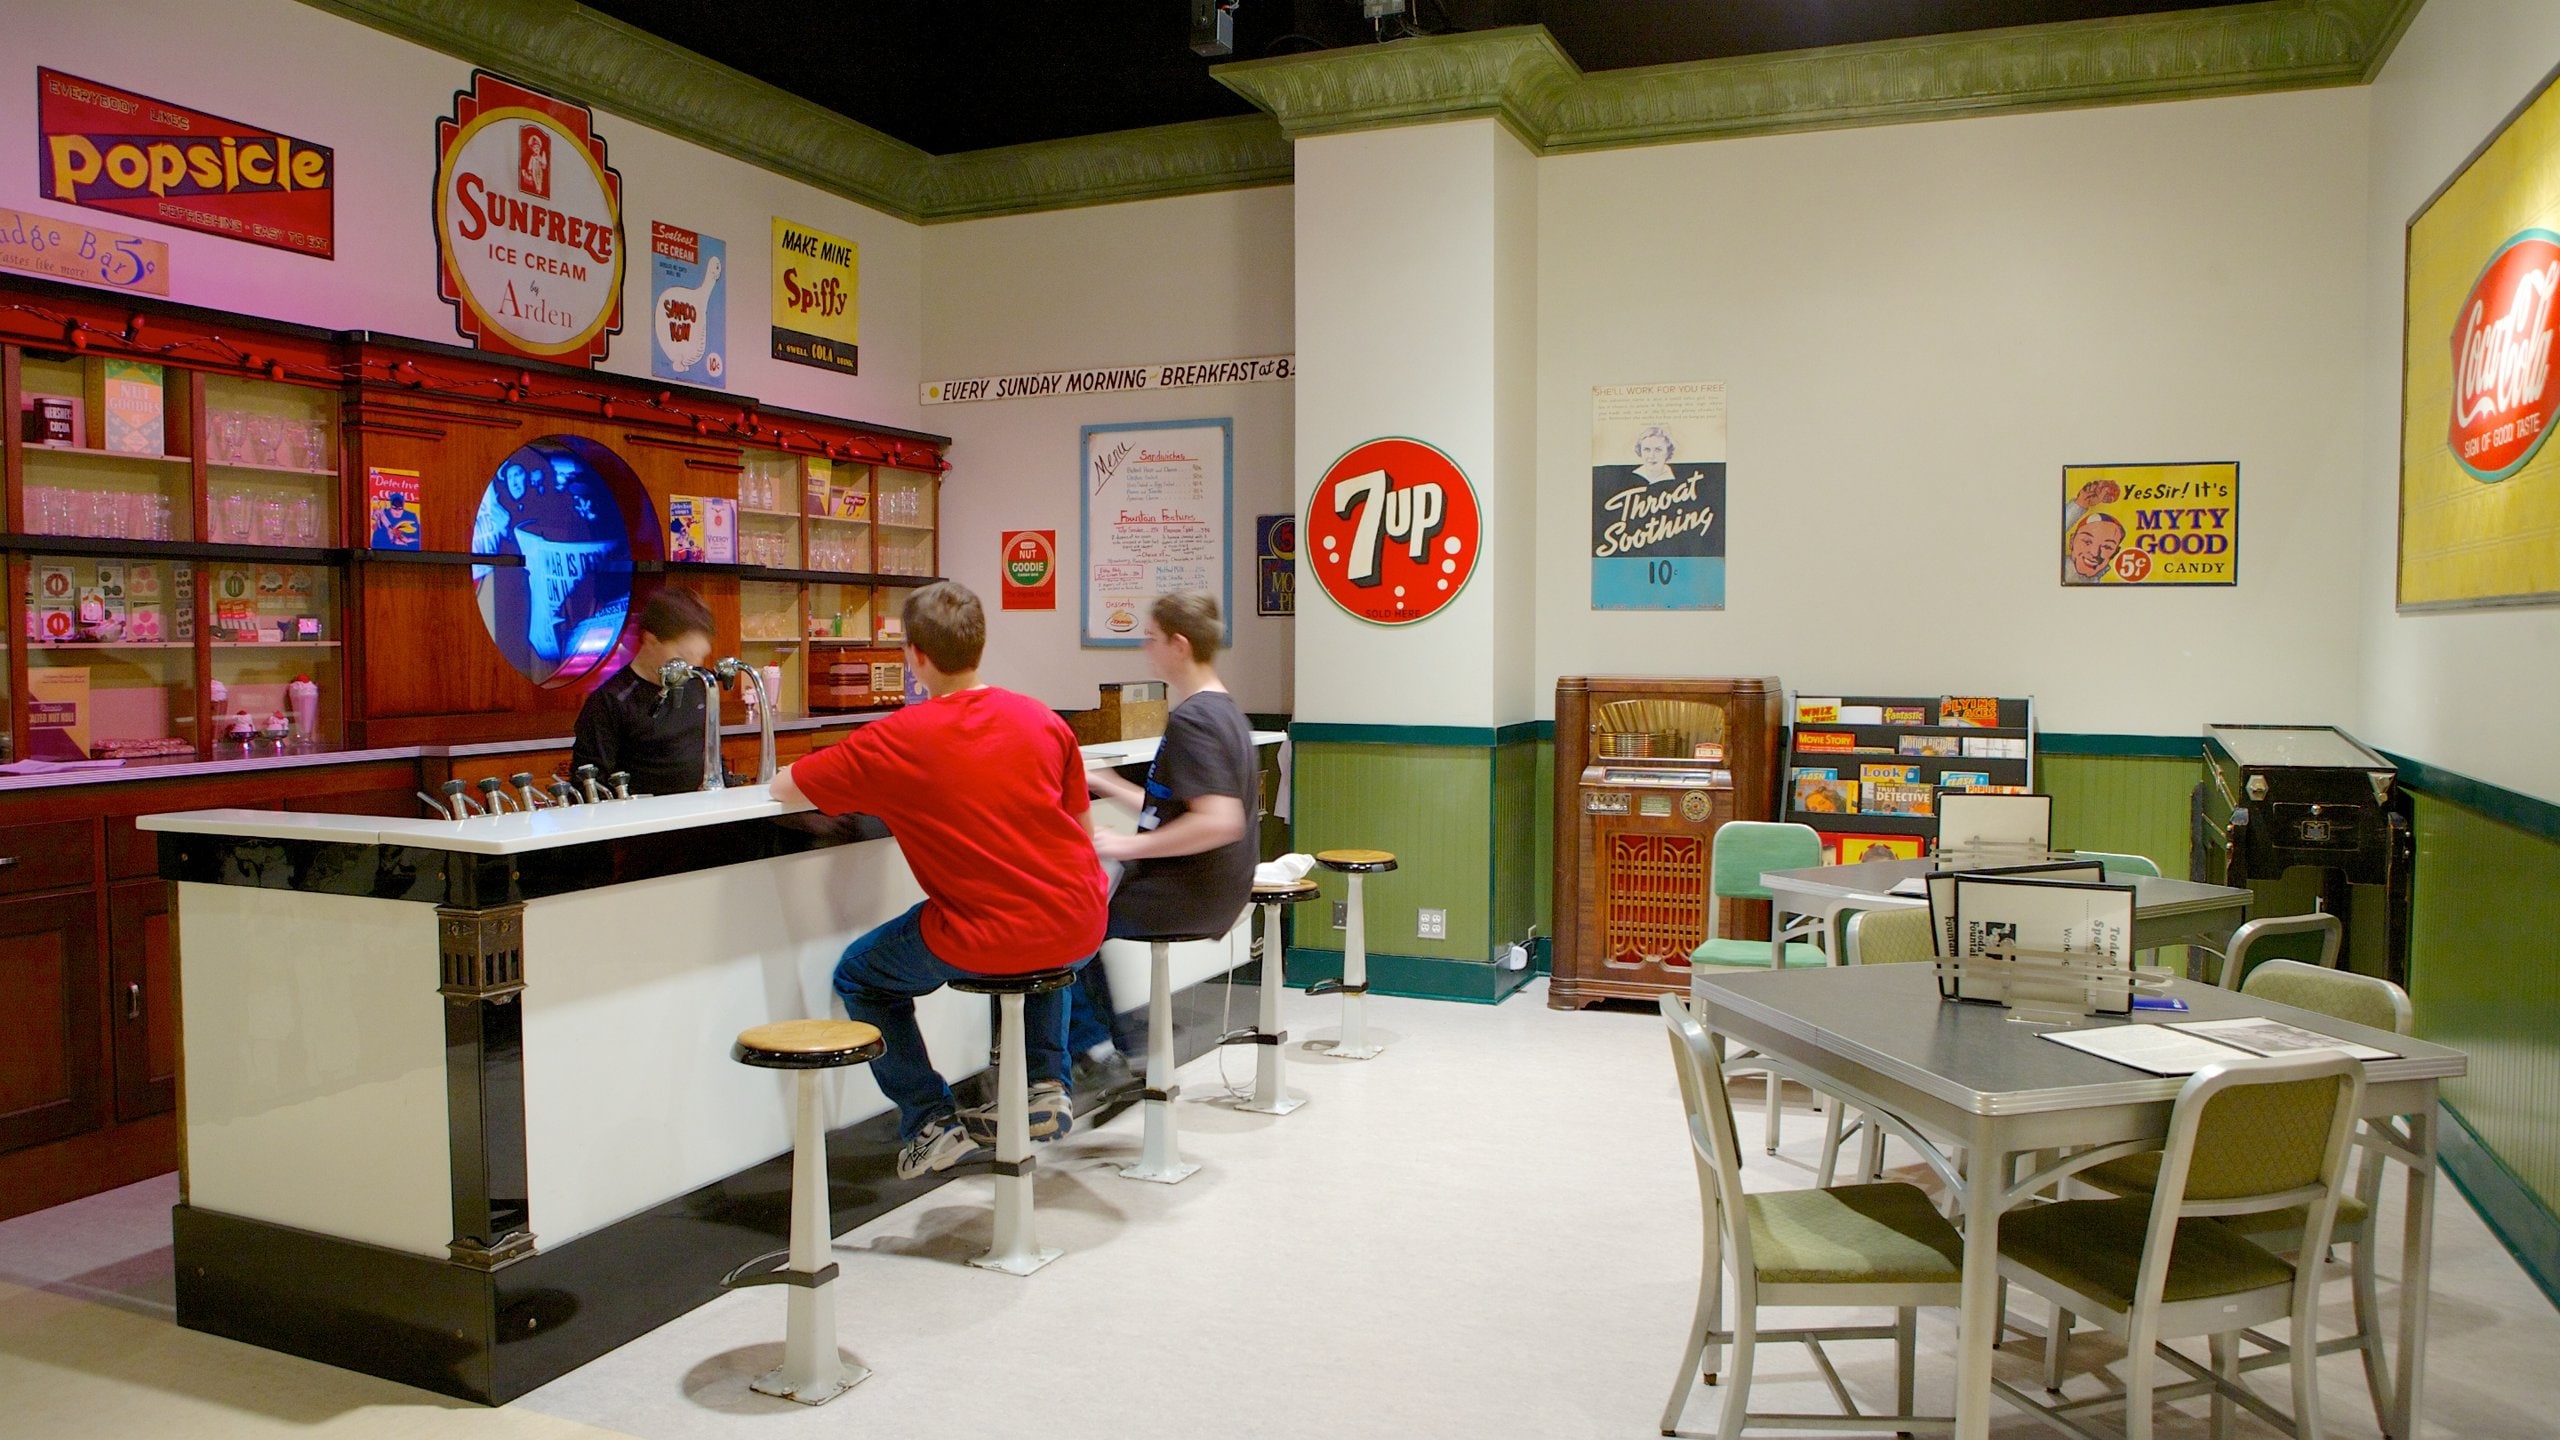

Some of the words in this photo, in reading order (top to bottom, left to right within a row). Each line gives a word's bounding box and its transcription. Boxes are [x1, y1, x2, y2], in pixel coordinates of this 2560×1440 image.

[49, 79, 139, 115] EVERYBODY
[150, 108, 190, 131] LIKES
[158, 202, 243, 233] REFRESHING
[252, 223, 284, 241] EASY
[287, 230, 304, 247] TO
[306, 235, 329, 251] EAT
[456, 171, 613, 264] SUNFREZE
[78, 229, 127, 275] Bar
[656, 240, 670, 255] ICE
[669, 244, 695, 263] CREAM
[782, 229, 818, 258] MAKE
[820, 241, 852, 268] MINE
[488, 243, 517, 266] ICE
[524, 252, 587, 282] CREAM
[529, 279, 540, 297] by
[783, 266, 848, 317] Spiffy
[497, 278, 573, 329] Arden
[776, 342, 783, 352] A
[786, 344, 809, 357] SWELL
[811, 343, 833, 363] COLA
[943, 380, 991, 401] EVERY
[996, 374, 1062, 398] SUNDAY
[1065, 368, 1147, 393] MORNING
[1160, 360, 1260, 387] BREAKFAST
[1259, 359, 1276, 376] at
[1626, 385, 1655, 395] WORK
[1657, 384, 1677, 394] FOR
[1679, 384, 1698, 393] YOU
[1700, 383, 1725, 393] FREE
[120, 383, 151, 400] NUT
[109, 397, 160, 414] GOODIES
[50, 420, 71, 433] COCOA
[2464, 437, 2480, 459] SIGN
[2481, 431, 2492, 453] OF
[2493, 422, 2514, 448] GOOD
[2517, 411, 2541, 439] TASTE
[1094, 441, 1131, 487] Menu
[1139, 449, 1186, 461] Sandwiches
[375, 475, 420, 490] Detective
[2122, 483, 2152, 500] Yes
[2153, 481, 2190, 499] Sir!
[2194, 480, 2228, 498] It's
[1604, 469, 1705, 522] Throat
[1119, 509, 1156, 523] Fountain
[1161, 508, 1196, 522] Features
[2135, 507, 2230, 531] MYTY
[1595, 506, 1714, 557] Soothing
[2135, 532, 2229, 555] GOOD
[565, 551, 578, 577] IS
[1019, 549, 1037, 560] NUT
[1011, 562, 1045, 573] GOODIE
[2163, 562, 2225, 574] CANDY
[1365, 608, 1391, 619] SOLD
[1394, 608, 1421, 619] HERE
[1800, 706, 1833, 717] WHIZ
[1941, 698, 1997, 716] FLYING
[1963, 707, 1997, 719] ACES
[1799, 734, 1825, 744] MOVIE
[1825, 734, 1852, 745] STORY
[1863, 767, 1901, 778] Look
[1876, 791, 1930, 803] DETECTIVE
[1977, 929, 1985, 953] soda
